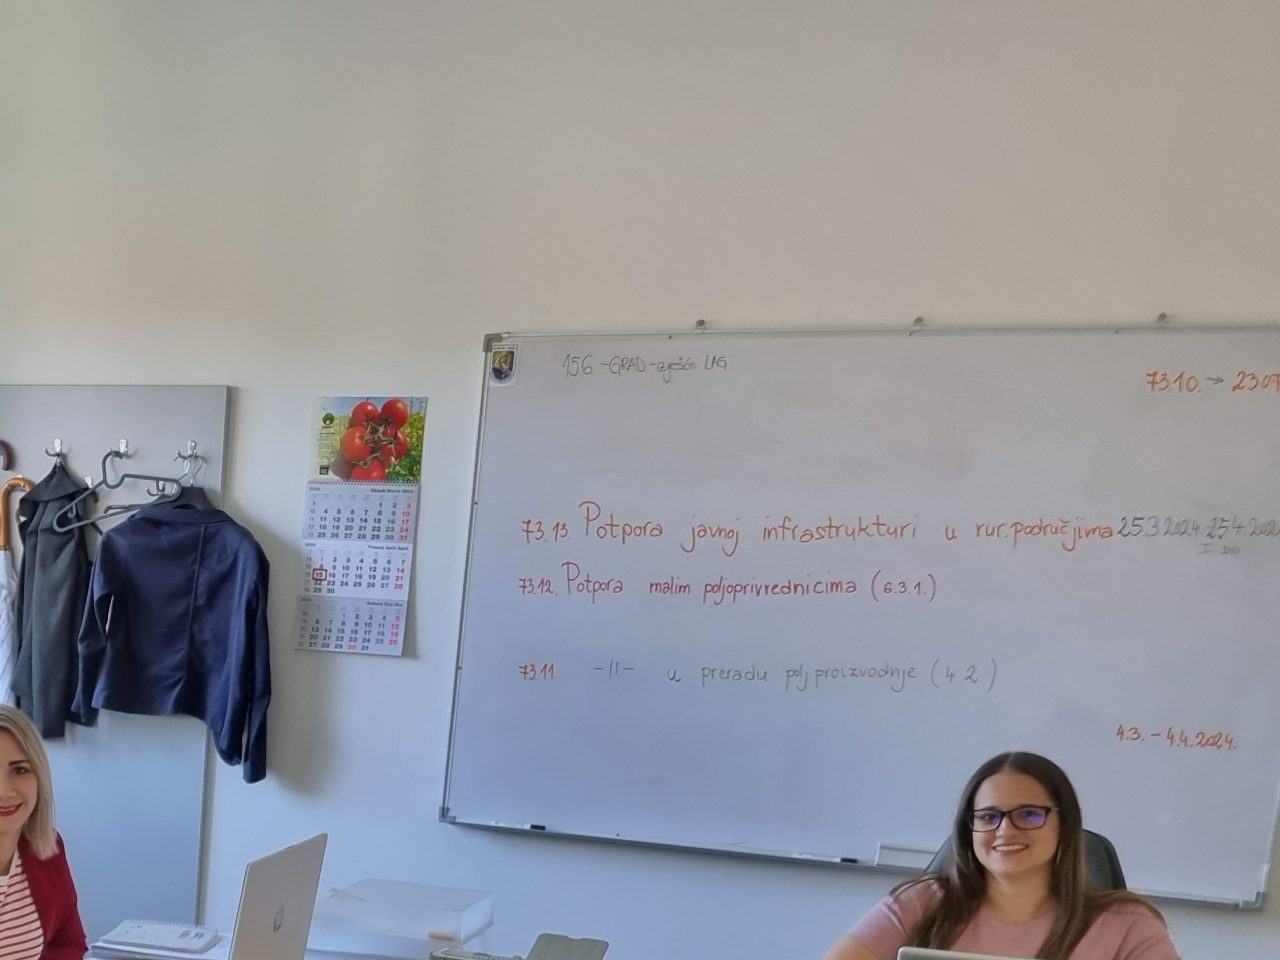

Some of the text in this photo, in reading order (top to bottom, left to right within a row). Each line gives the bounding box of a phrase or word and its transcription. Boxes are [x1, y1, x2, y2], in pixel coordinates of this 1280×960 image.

[562, 353, 593, 377] 156
[578, 501, 664, 544] Potpora
[680, 514, 740, 557] javnoj
[763, 513, 919, 543] infrastrukturi
[944, 525, 959, 540] u
[561, 560, 624, 604] Potpora
[649, 575, 691, 595] malim
[703, 571, 857, 606] poljoprivrednicima
[667, 668, 682, 683] u
[702, 664, 768, 687] preradu
